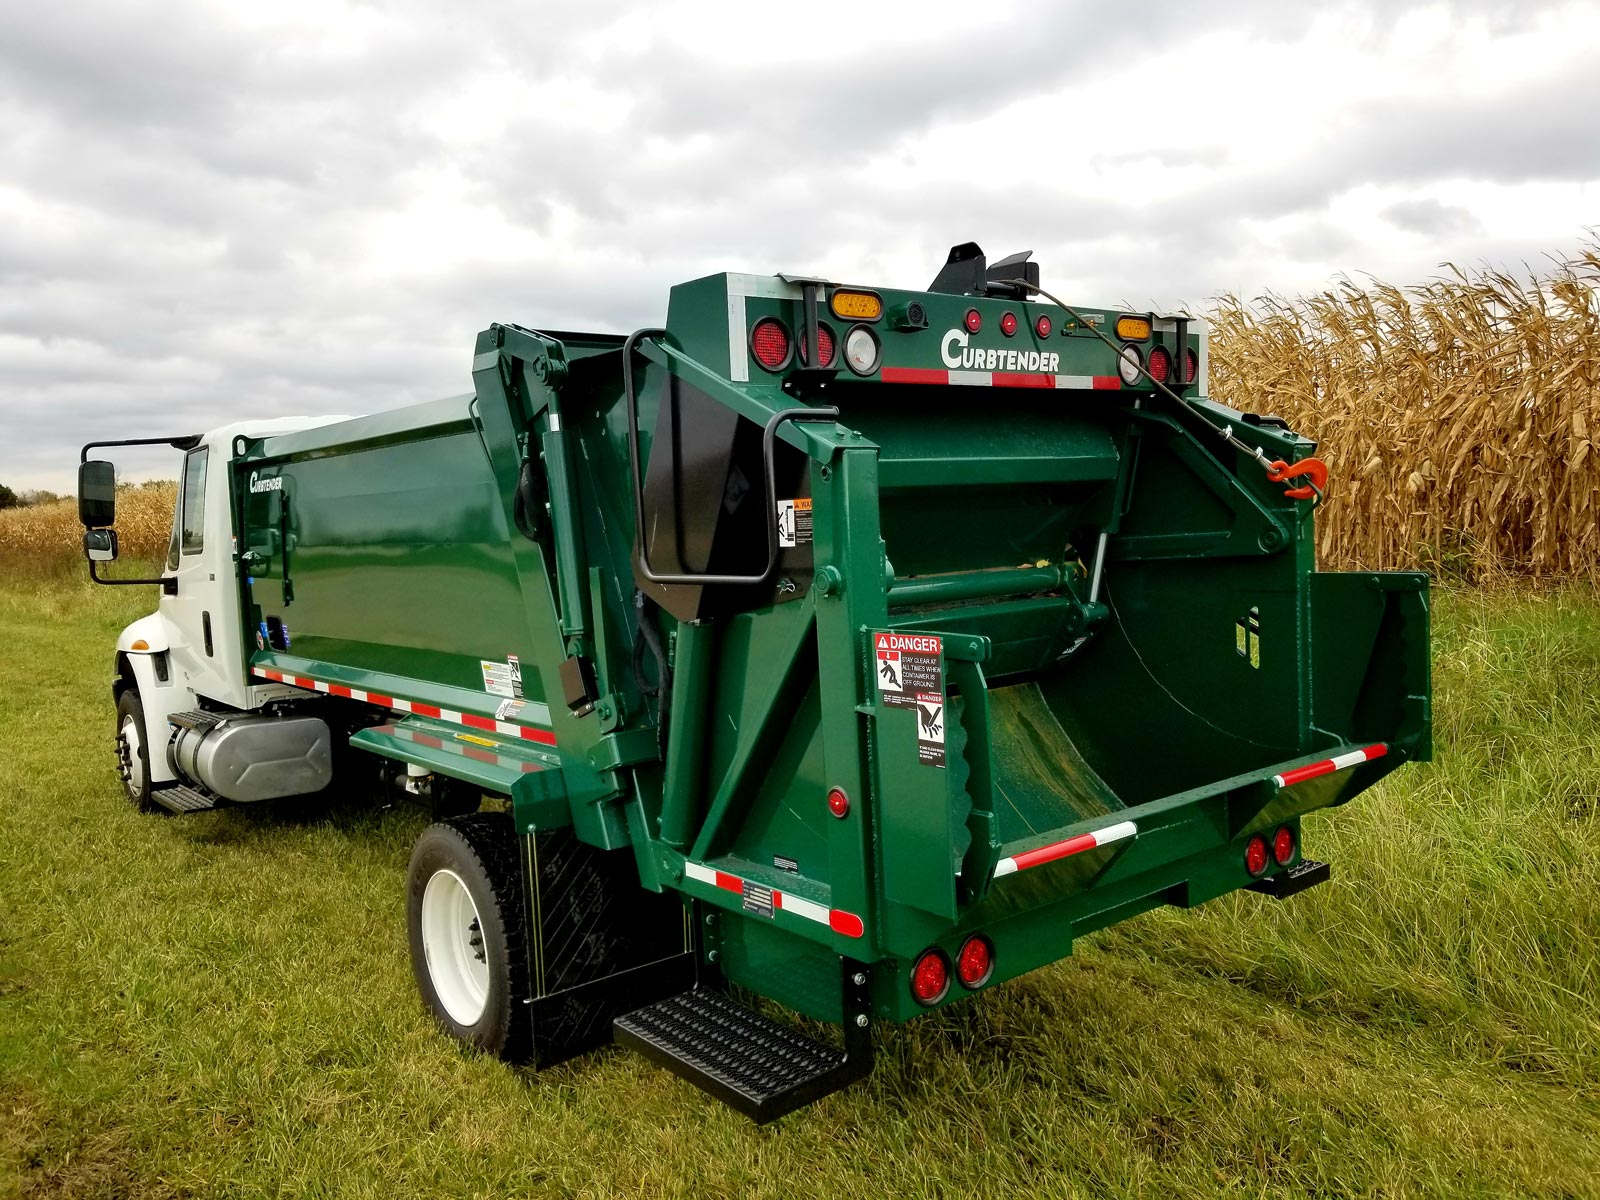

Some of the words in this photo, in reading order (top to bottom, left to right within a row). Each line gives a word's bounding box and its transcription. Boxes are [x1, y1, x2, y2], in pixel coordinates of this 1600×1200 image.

[941, 328, 1060, 372] CURBTENDER
[249, 471, 283, 493] CURBTENDER
[890, 636, 938, 652] DANGER
[911, 664, 926, 672] TIMES
[902, 671, 930, 680] CONTAINER
[912, 680, 935, 688] GROUND
[922, 694, 942, 703] DANGER
